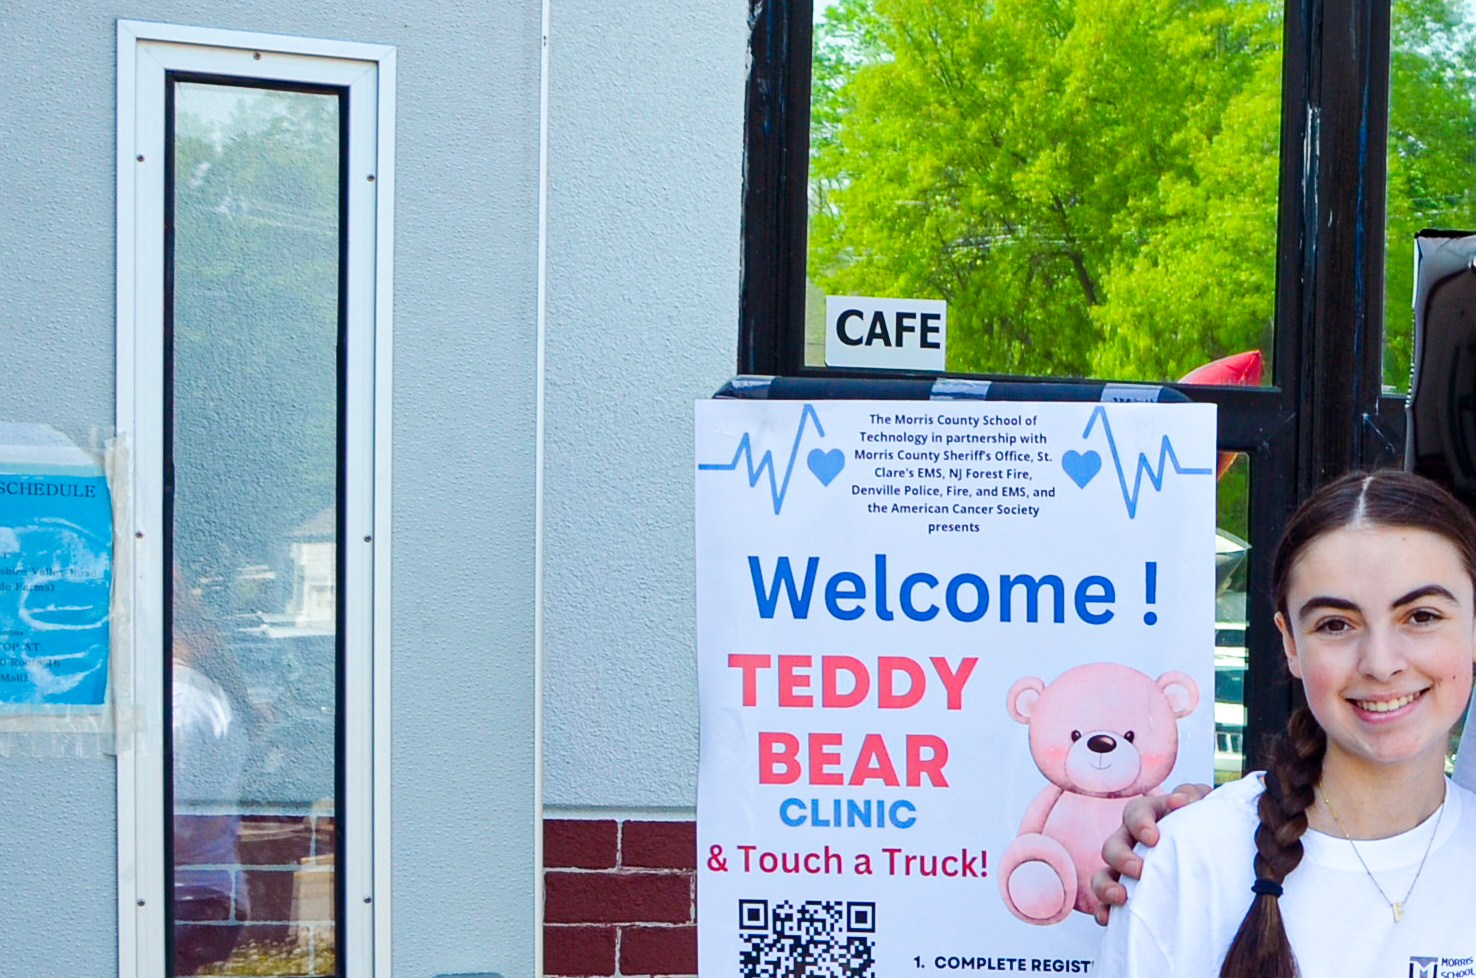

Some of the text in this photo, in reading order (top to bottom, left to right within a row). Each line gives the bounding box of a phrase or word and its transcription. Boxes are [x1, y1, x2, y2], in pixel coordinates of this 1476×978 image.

[835, 308, 942, 350] CAFE
[869, 413, 1038, 429] The Morris County School of
[859, 431, 1047, 447] Technology in partnership with
[854, 449, 1053, 464] Morris County Sheriff's Office, St.
[874, 466, 1033, 481] Clare's EMS, NJ Forest Fire,
[851, 484, 1056, 499] Denville Police, Fire, and EMS, and
[867, 502, 1040, 518] the American Cancer Society
[928, 522, 980, 535] presents
[747, 553, 1158, 626] Welcome !
[727, 653, 979, 711] TEDDY
[758, 731, 950, 788] BEAR
[779, 797, 917, 830] CLINIC
[706, 844, 988, 878] & Touch a Truck!
[913, 955, 1095, 974] 1. COMPLETE REGIST
[1441, 957, 1474, 968] MORRIS
